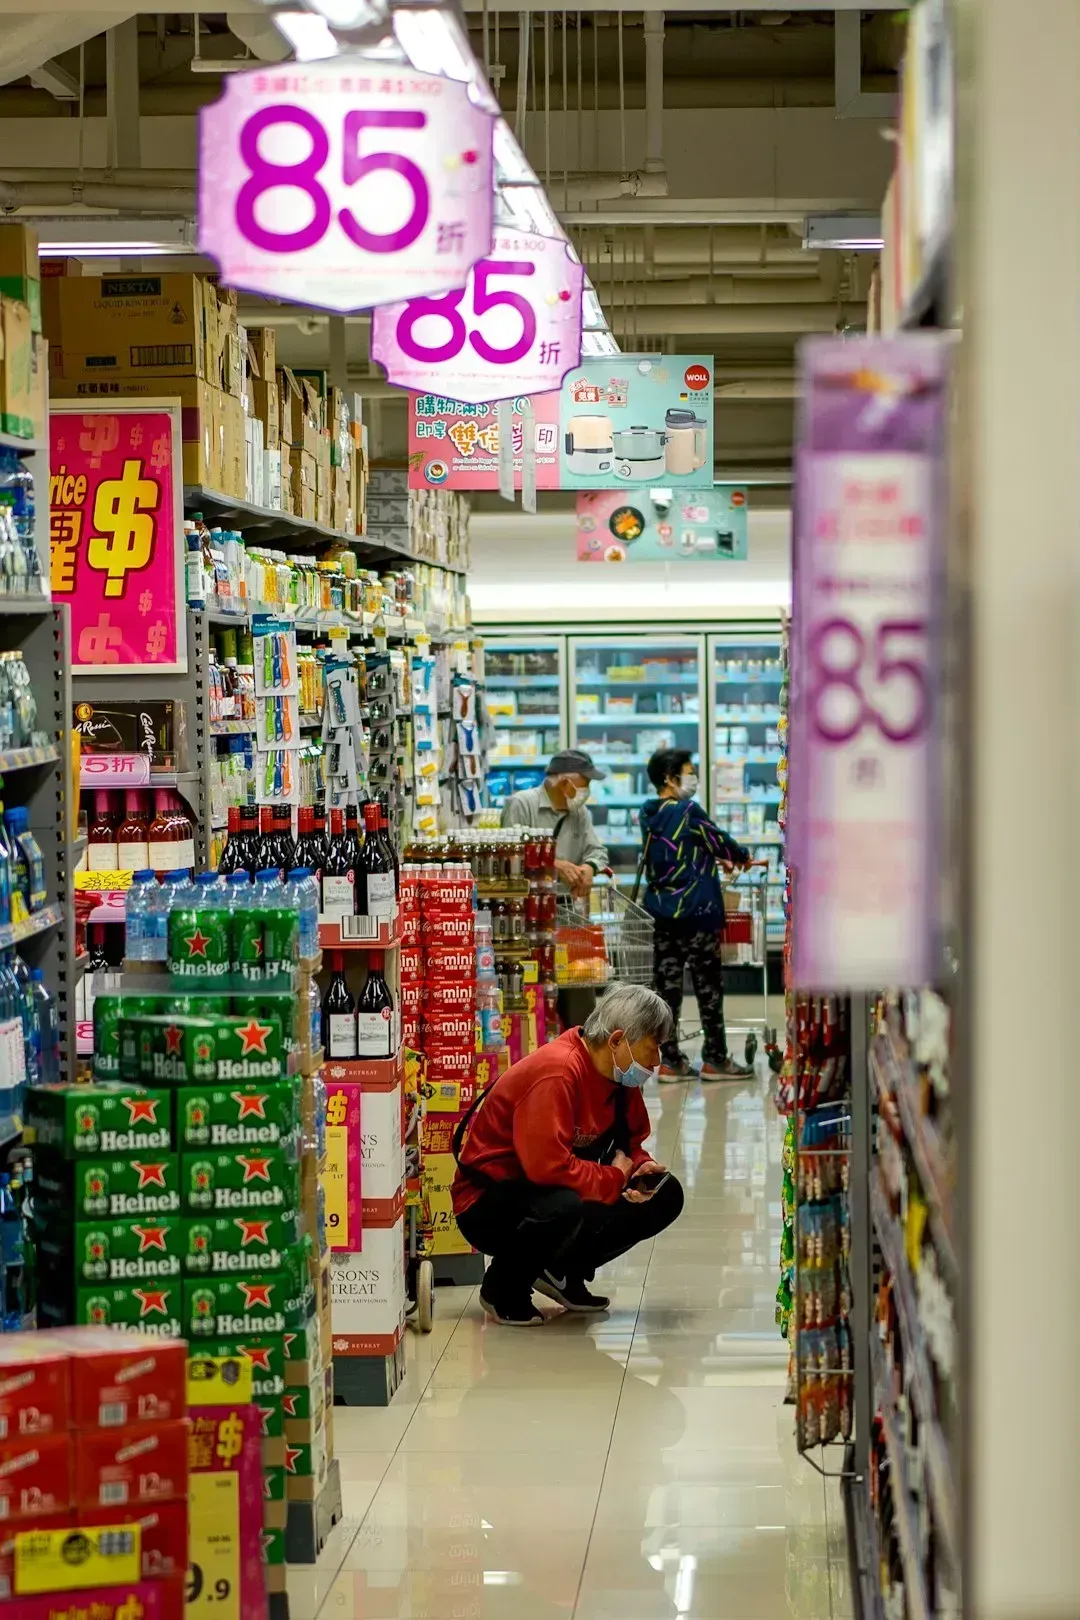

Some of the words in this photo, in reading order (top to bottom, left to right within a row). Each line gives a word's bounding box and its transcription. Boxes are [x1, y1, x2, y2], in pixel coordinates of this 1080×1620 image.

[234, 104, 430, 254] 85
[108, 282, 155, 293] NEKTA
[396, 261, 537, 364] 85
[540, 341, 561, 365] 折
[538, 428, 553, 445] 印
[49, 465, 87, 506] rice
[88, 460, 158, 597] $
[808, 618, 932, 745] 85
[79, 756, 135, 773] 5折
[399, 884, 414, 897] ini
[440, 885, 469, 898] mini
[443, 918, 471, 931] mini
[444, 952, 473, 965] mini
[443, 985, 472, 999] mini
[442, 1018, 471, 1032] mini
[442, 1051, 472, 1065] mini
[327, 1090, 347, 1126] $
